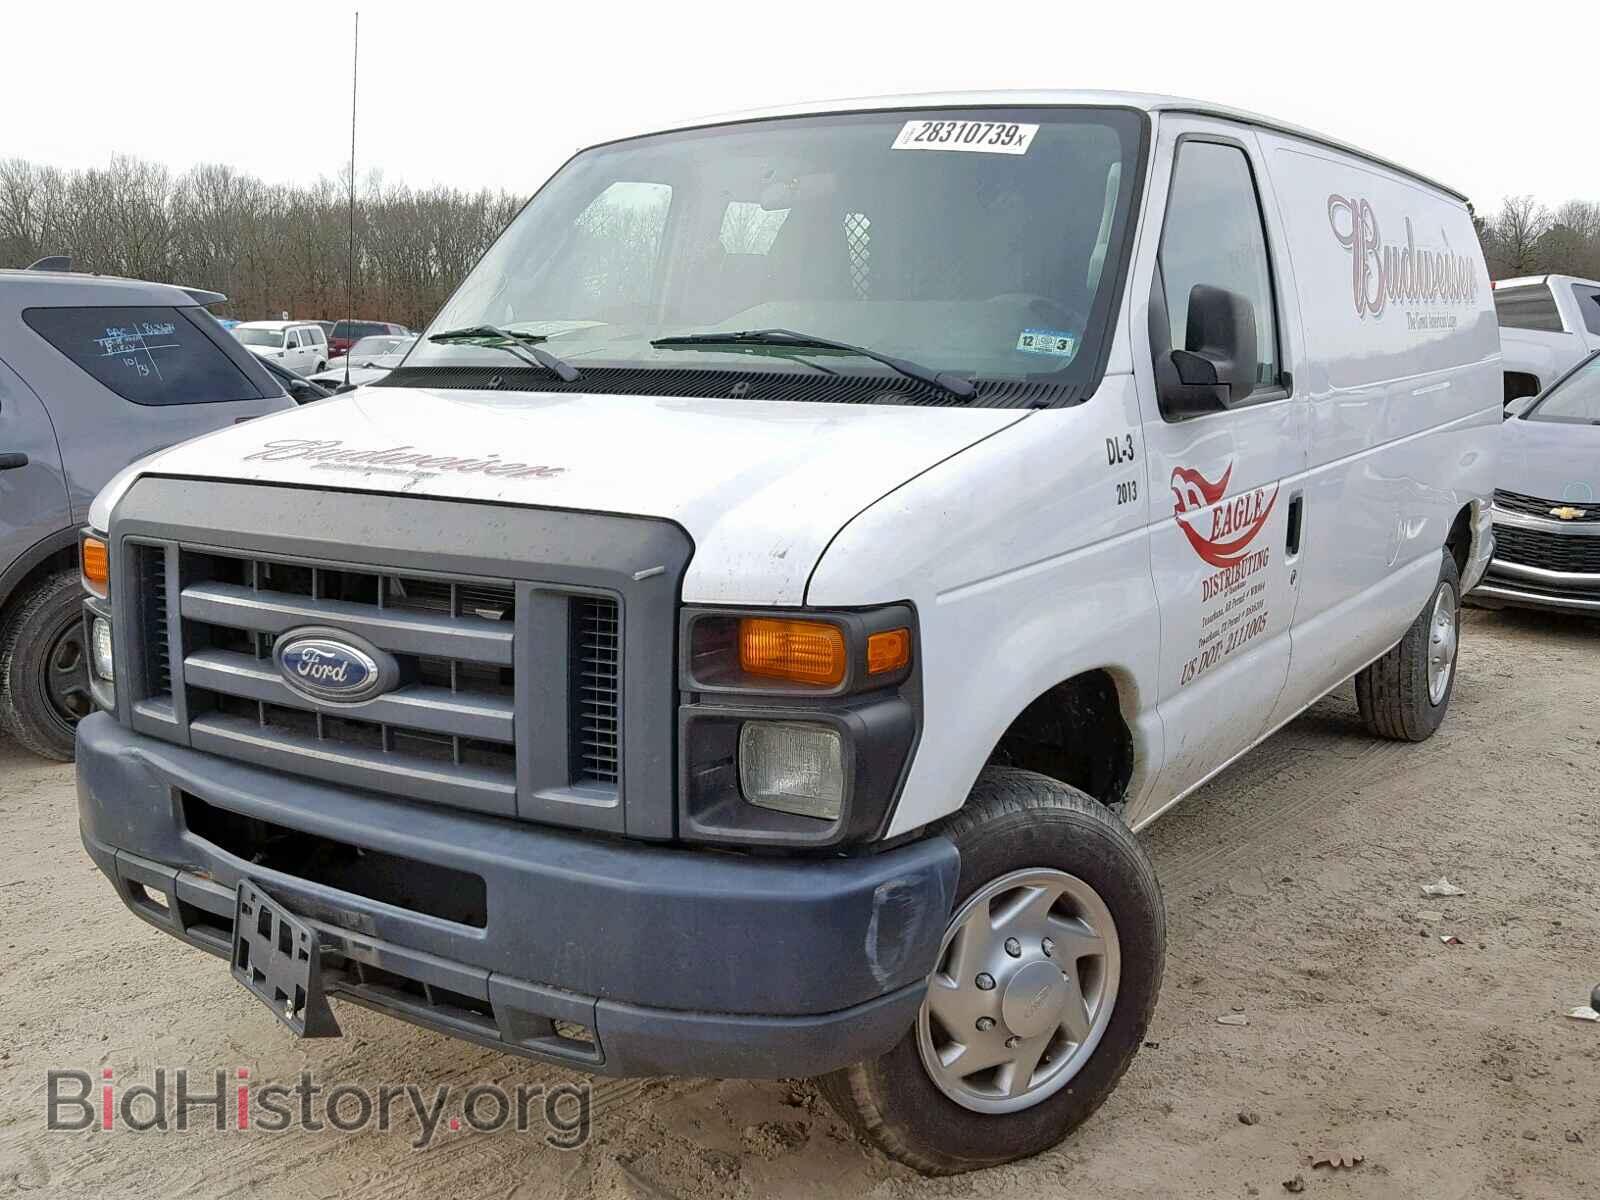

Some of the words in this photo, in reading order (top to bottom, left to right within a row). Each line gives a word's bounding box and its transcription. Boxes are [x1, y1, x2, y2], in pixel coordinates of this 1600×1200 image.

[914, 121, 1019, 146] 28310739
[1327, 194, 1477, 319] Budweiser
[1023, 335, 1034, 347] 12
[1056, 339, 1068, 351] 3
[1105, 433, 1134, 466] DL-3
[1116, 480, 1137, 505] 2013
[1209, 489, 1265, 542] EAGLE
[1202, 547, 1269, 602] DISTRIBUTING
[297, 647, 349, 682] Ford
[1181, 656, 1198, 685] US
